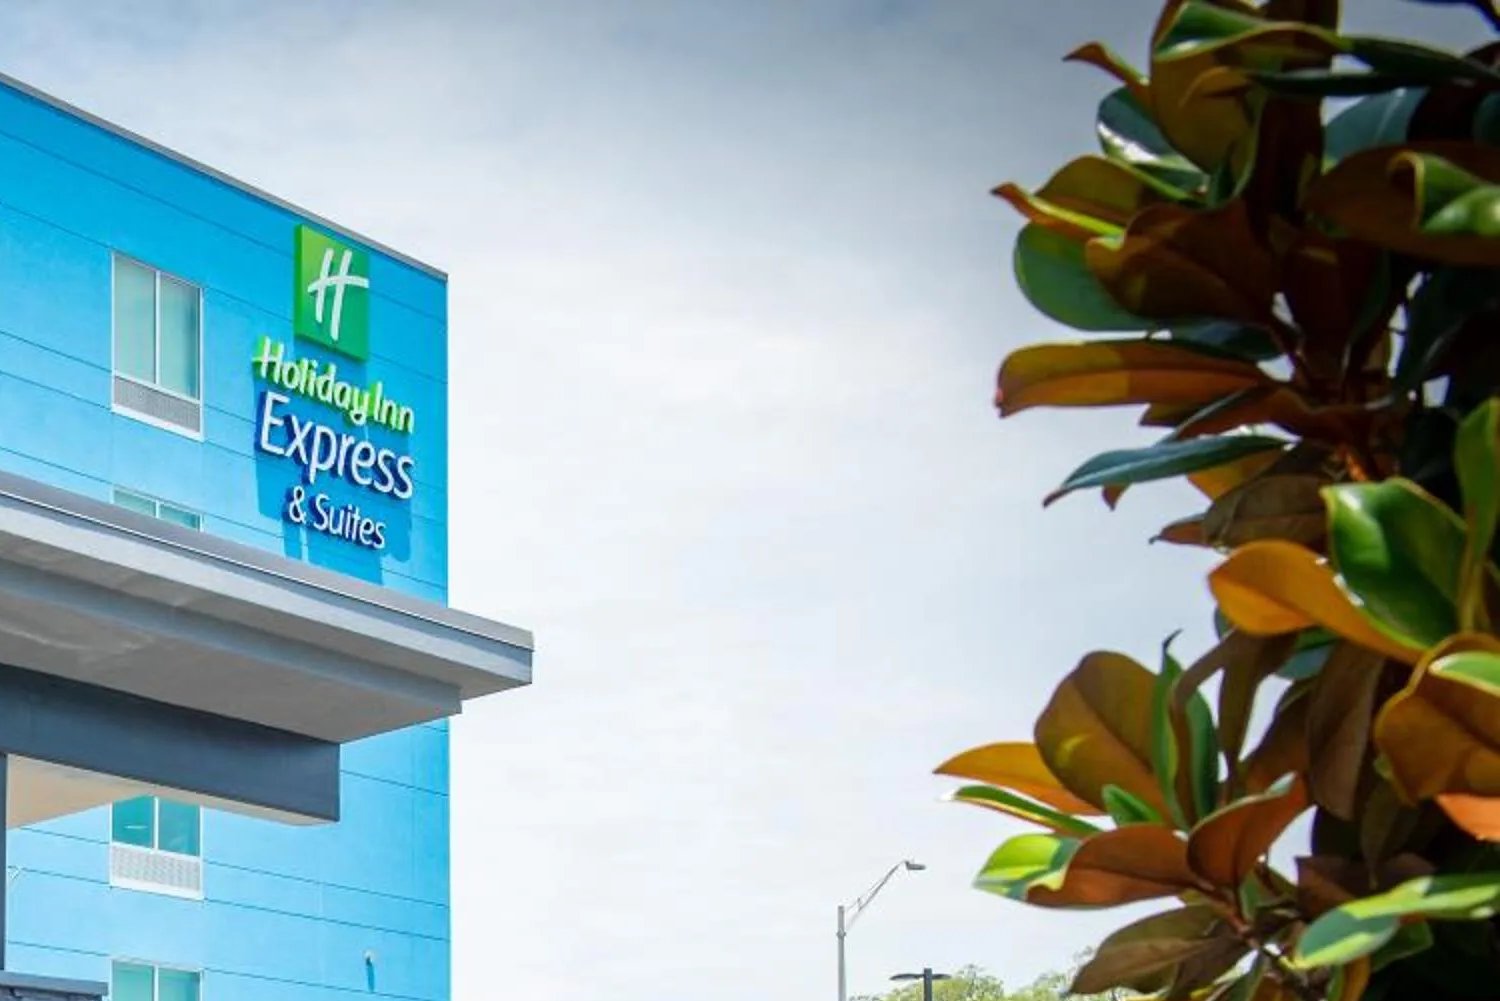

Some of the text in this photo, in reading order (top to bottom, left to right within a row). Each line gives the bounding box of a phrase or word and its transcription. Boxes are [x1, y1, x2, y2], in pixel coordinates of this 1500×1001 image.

[253, 336, 415, 434] Holiday Inn
[260, 391, 415, 500] Express
[287, 485, 386, 550] & Suites
